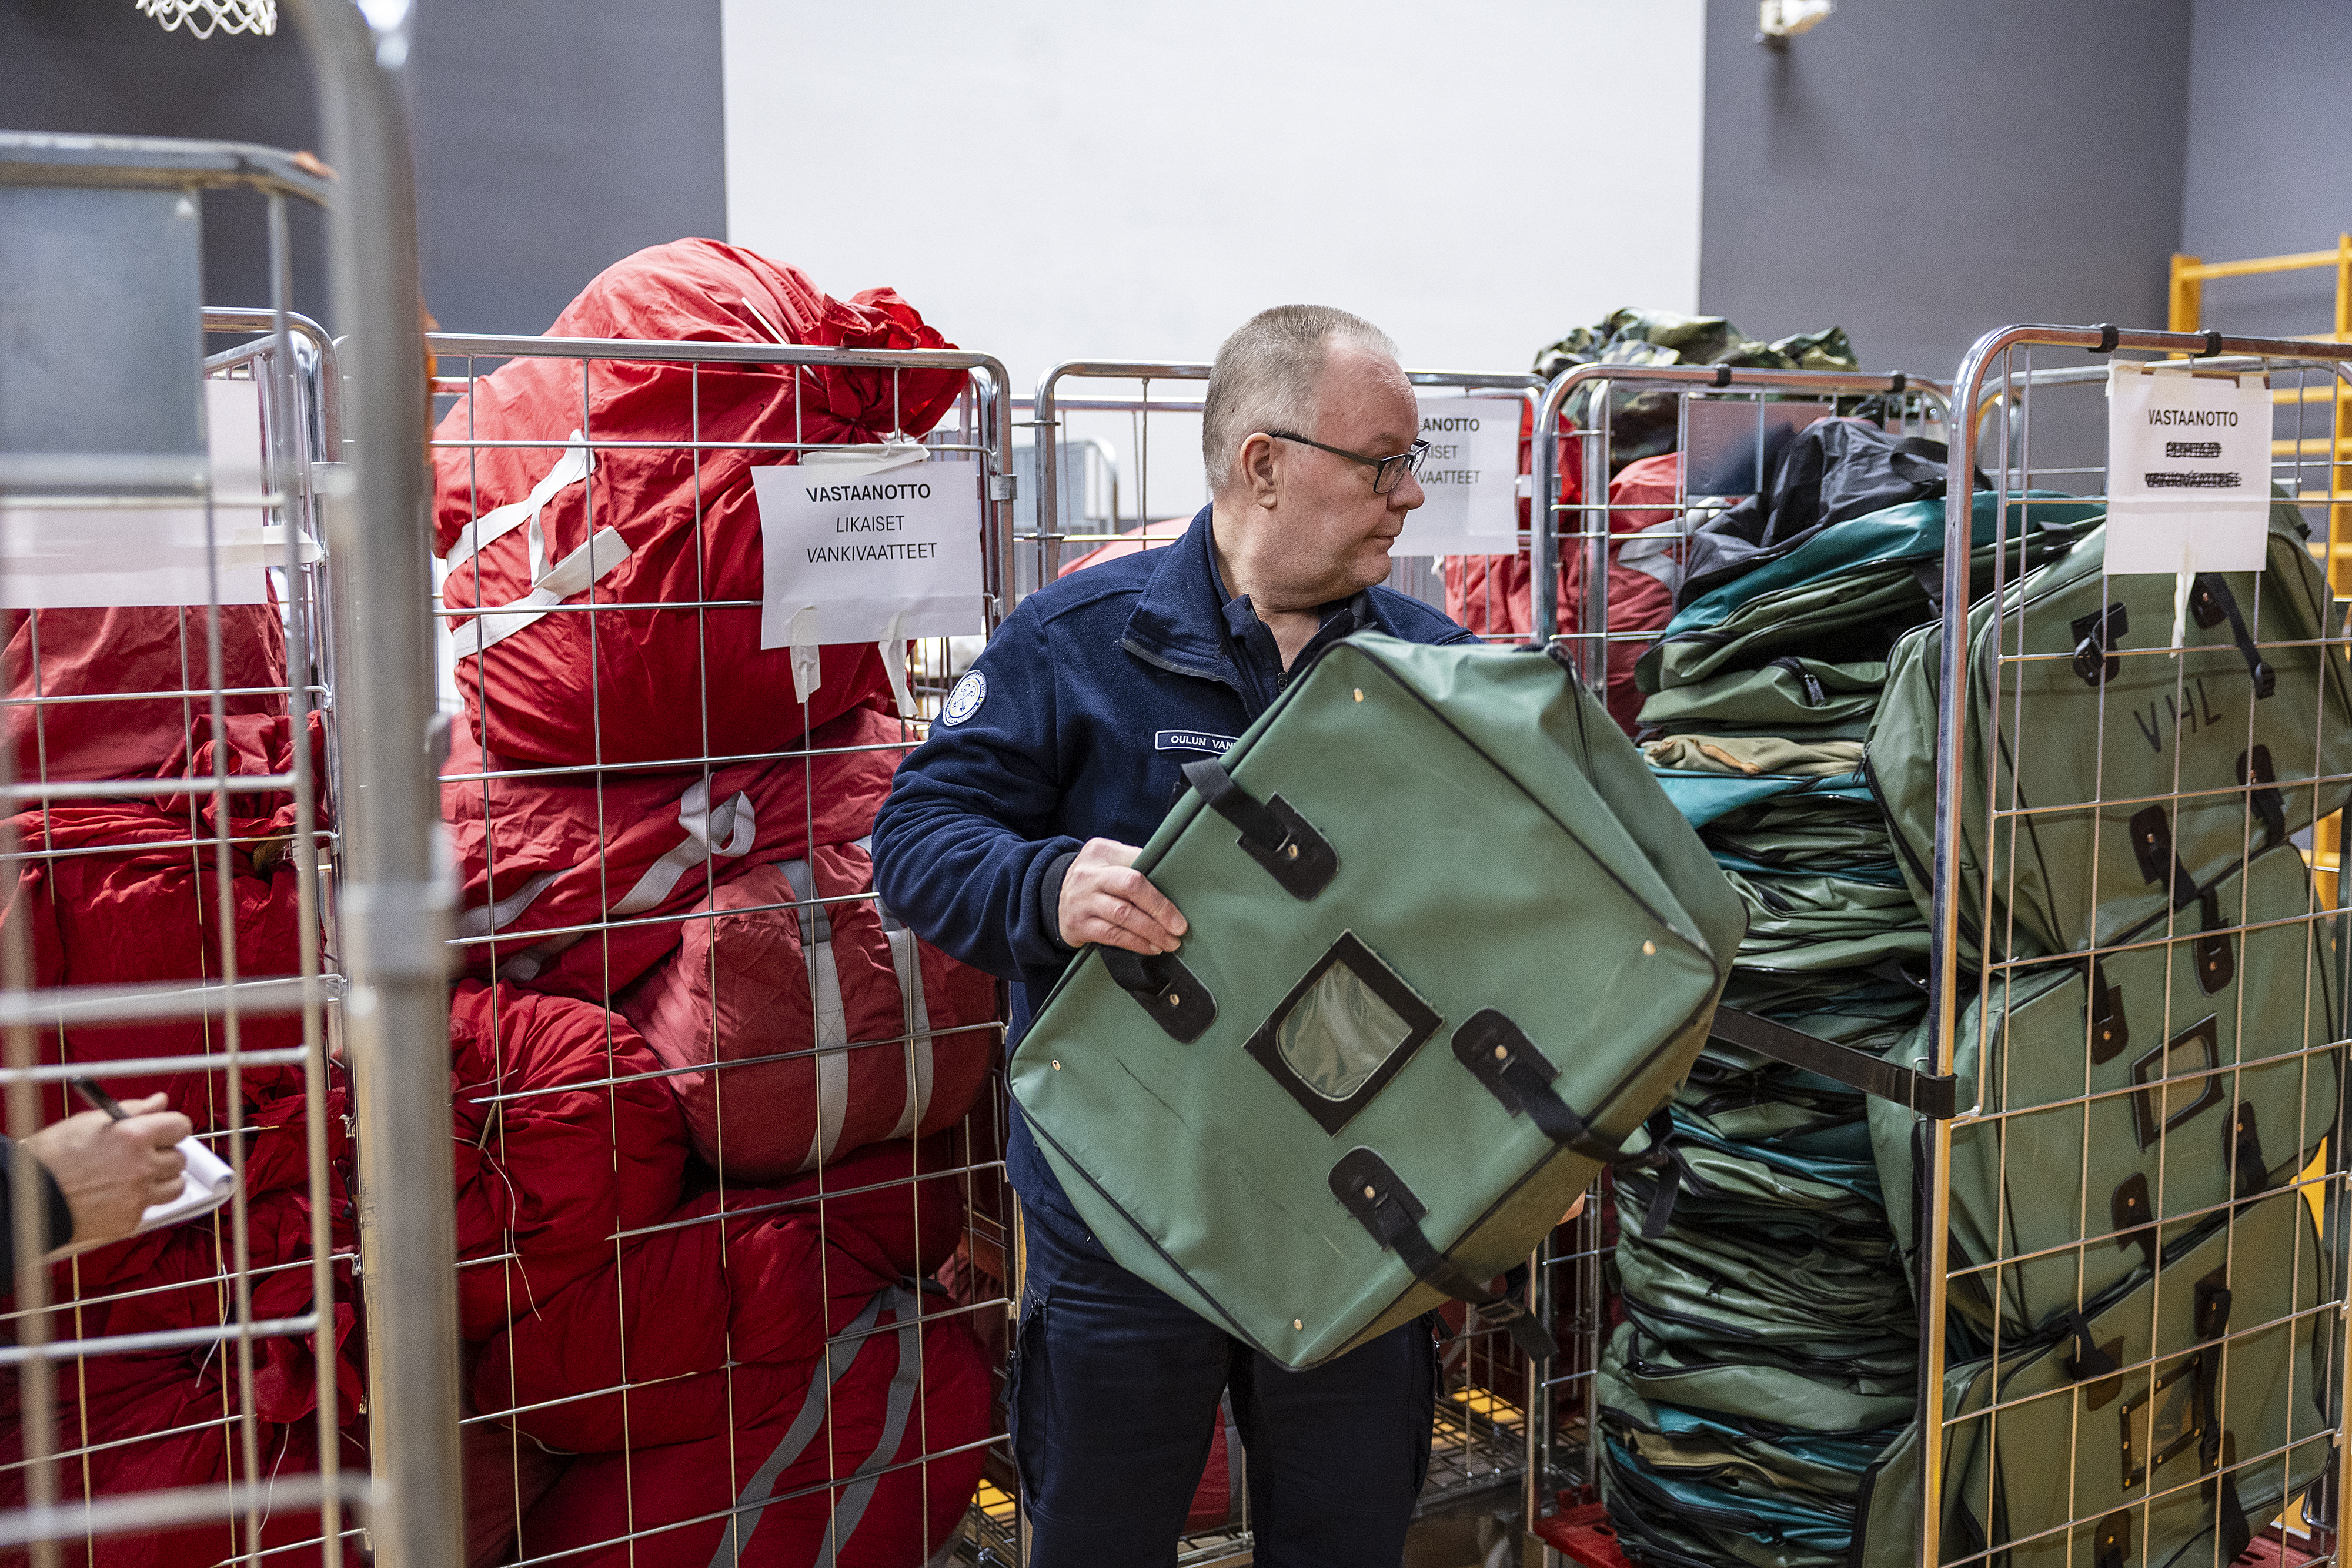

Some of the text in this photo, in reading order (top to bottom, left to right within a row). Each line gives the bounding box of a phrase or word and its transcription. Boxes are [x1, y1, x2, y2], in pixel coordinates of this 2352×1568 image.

[1422, 418, 1480, 432] ANOTTO
[2148, 409, 2239, 427] VASTAANOTTO
[806, 483, 931, 502] VASTAANOTTO
[836, 515, 905, 533] LIKAISET
[807, 543, 937, 563] VANKIVAATTEET
[1170, 735, 1235, 750] OULUN VAN
